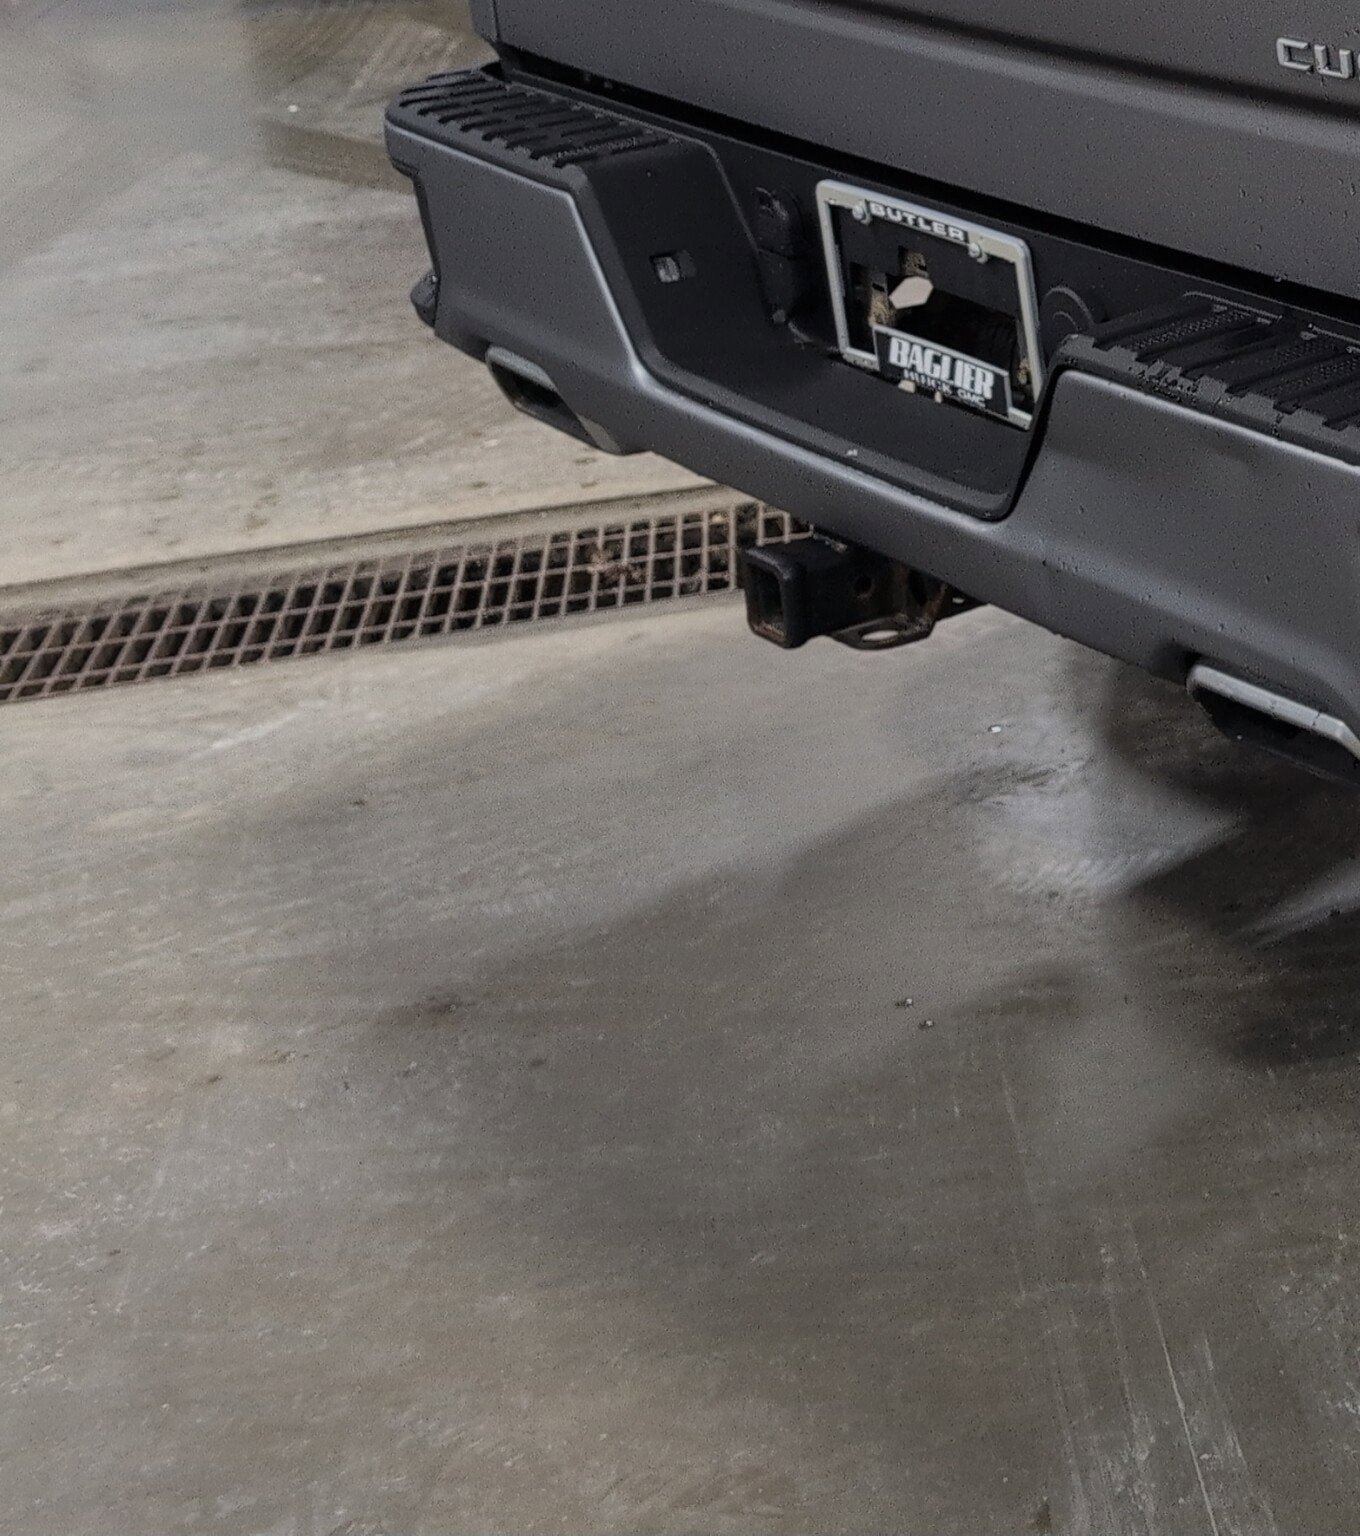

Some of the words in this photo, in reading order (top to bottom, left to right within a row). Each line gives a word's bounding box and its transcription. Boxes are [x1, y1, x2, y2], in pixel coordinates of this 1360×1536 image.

[870, 202, 965, 242] BUTLER
[889, 336, 995, 400] BAGLIER
[956, 387, 987, 409] GMC
